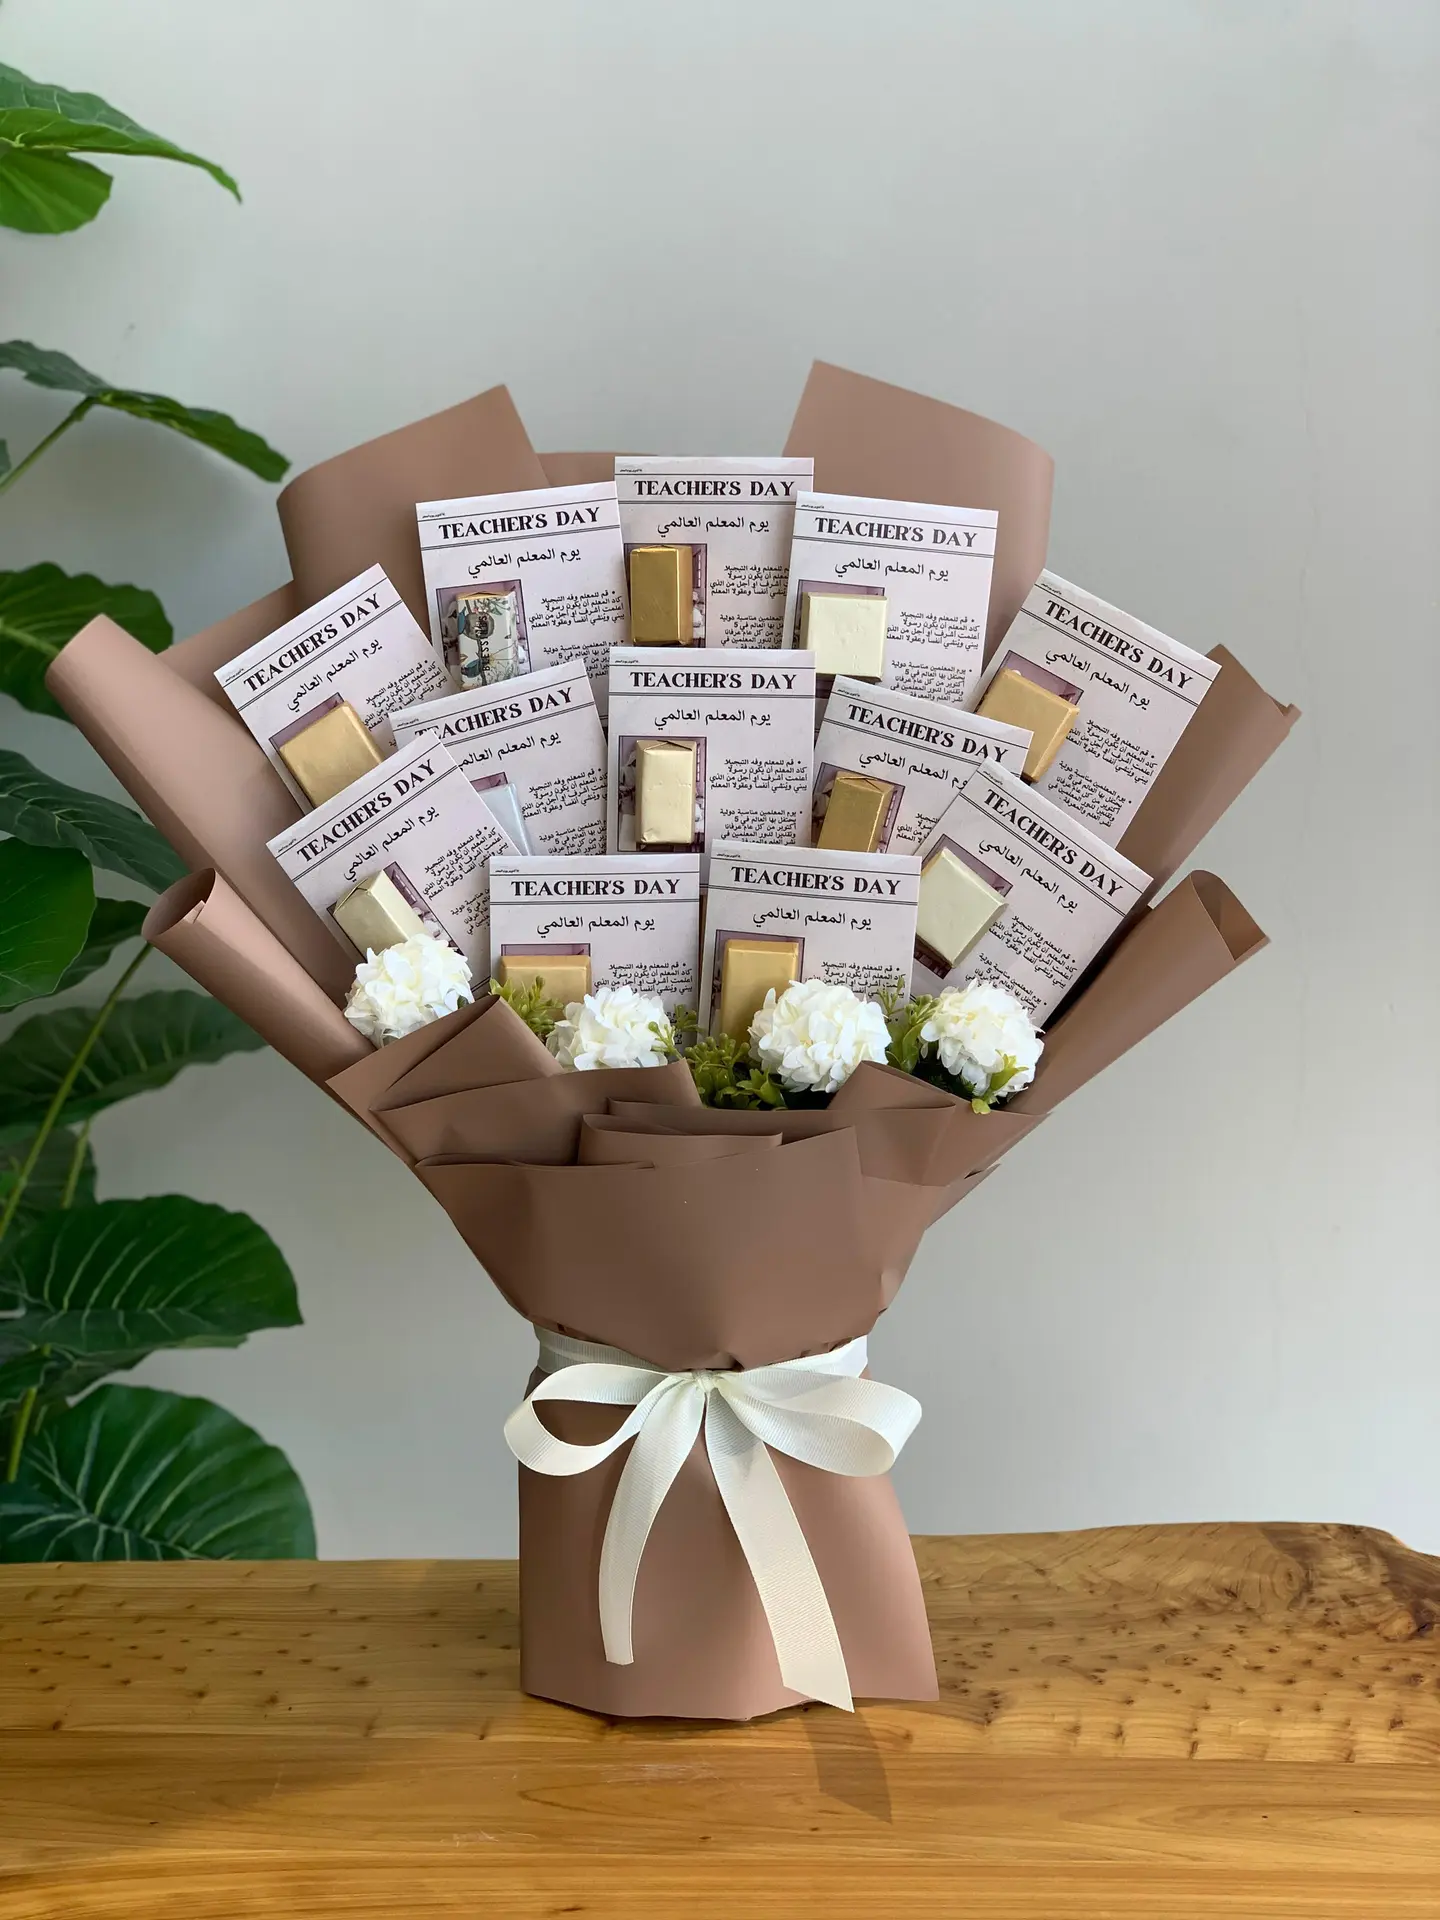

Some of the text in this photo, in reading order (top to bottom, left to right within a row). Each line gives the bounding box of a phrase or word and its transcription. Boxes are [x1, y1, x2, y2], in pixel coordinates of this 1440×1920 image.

[634, 480, 794, 496] TEACHER'S DAY
[438, 507, 599, 539] TEACHER'S DAY
[657, 517, 769, 538] يوم المعلم العالمي
[815, 517, 977, 547] TEACHER'S DAY
[468, 548, 581, 579] يوم المعلم العالمي
[835, 558, 948, 582] يوم المعلم العالمي
[243, 593, 380, 691] TEACHER'S DAY
[1046, 600, 1193, 689] TEACHER'S DAY
[288, 640, 382, 713] يوم المعلم العالمي
[630, 672, 796, 689] TEACHER'S DAY
[1046, 651, 1150, 710] يوم المعلم العالمي
[528, 687, 571, 713] DAY
[654, 709, 771, 730] يوم المعلم العالمي
[848, 704, 1008, 763] TEACHER'S DAY
[458, 732, 561, 772] يوم المعلم العالم
[859, 752, 906, 768] العالمي
[908, 763, 948, 780] المعلم
[951, 777, 968, 789] وم
[297, 759, 434, 862] TEACHER'S DAY
[344, 807, 439, 883] يوم المعلم العالمي
[984, 789, 1123, 896] TEACHER'S DAY
[511, 879, 680, 896] TEACHER'S DAY
[731, 867, 900, 896] TEACHER'S DAY
[979, 840, 1078, 914] يوم المعلم العالمي
[537, 916, 655, 938] يوم المعلم العالمي
[753, 908, 871, 930] يوم المعلم العالمي
